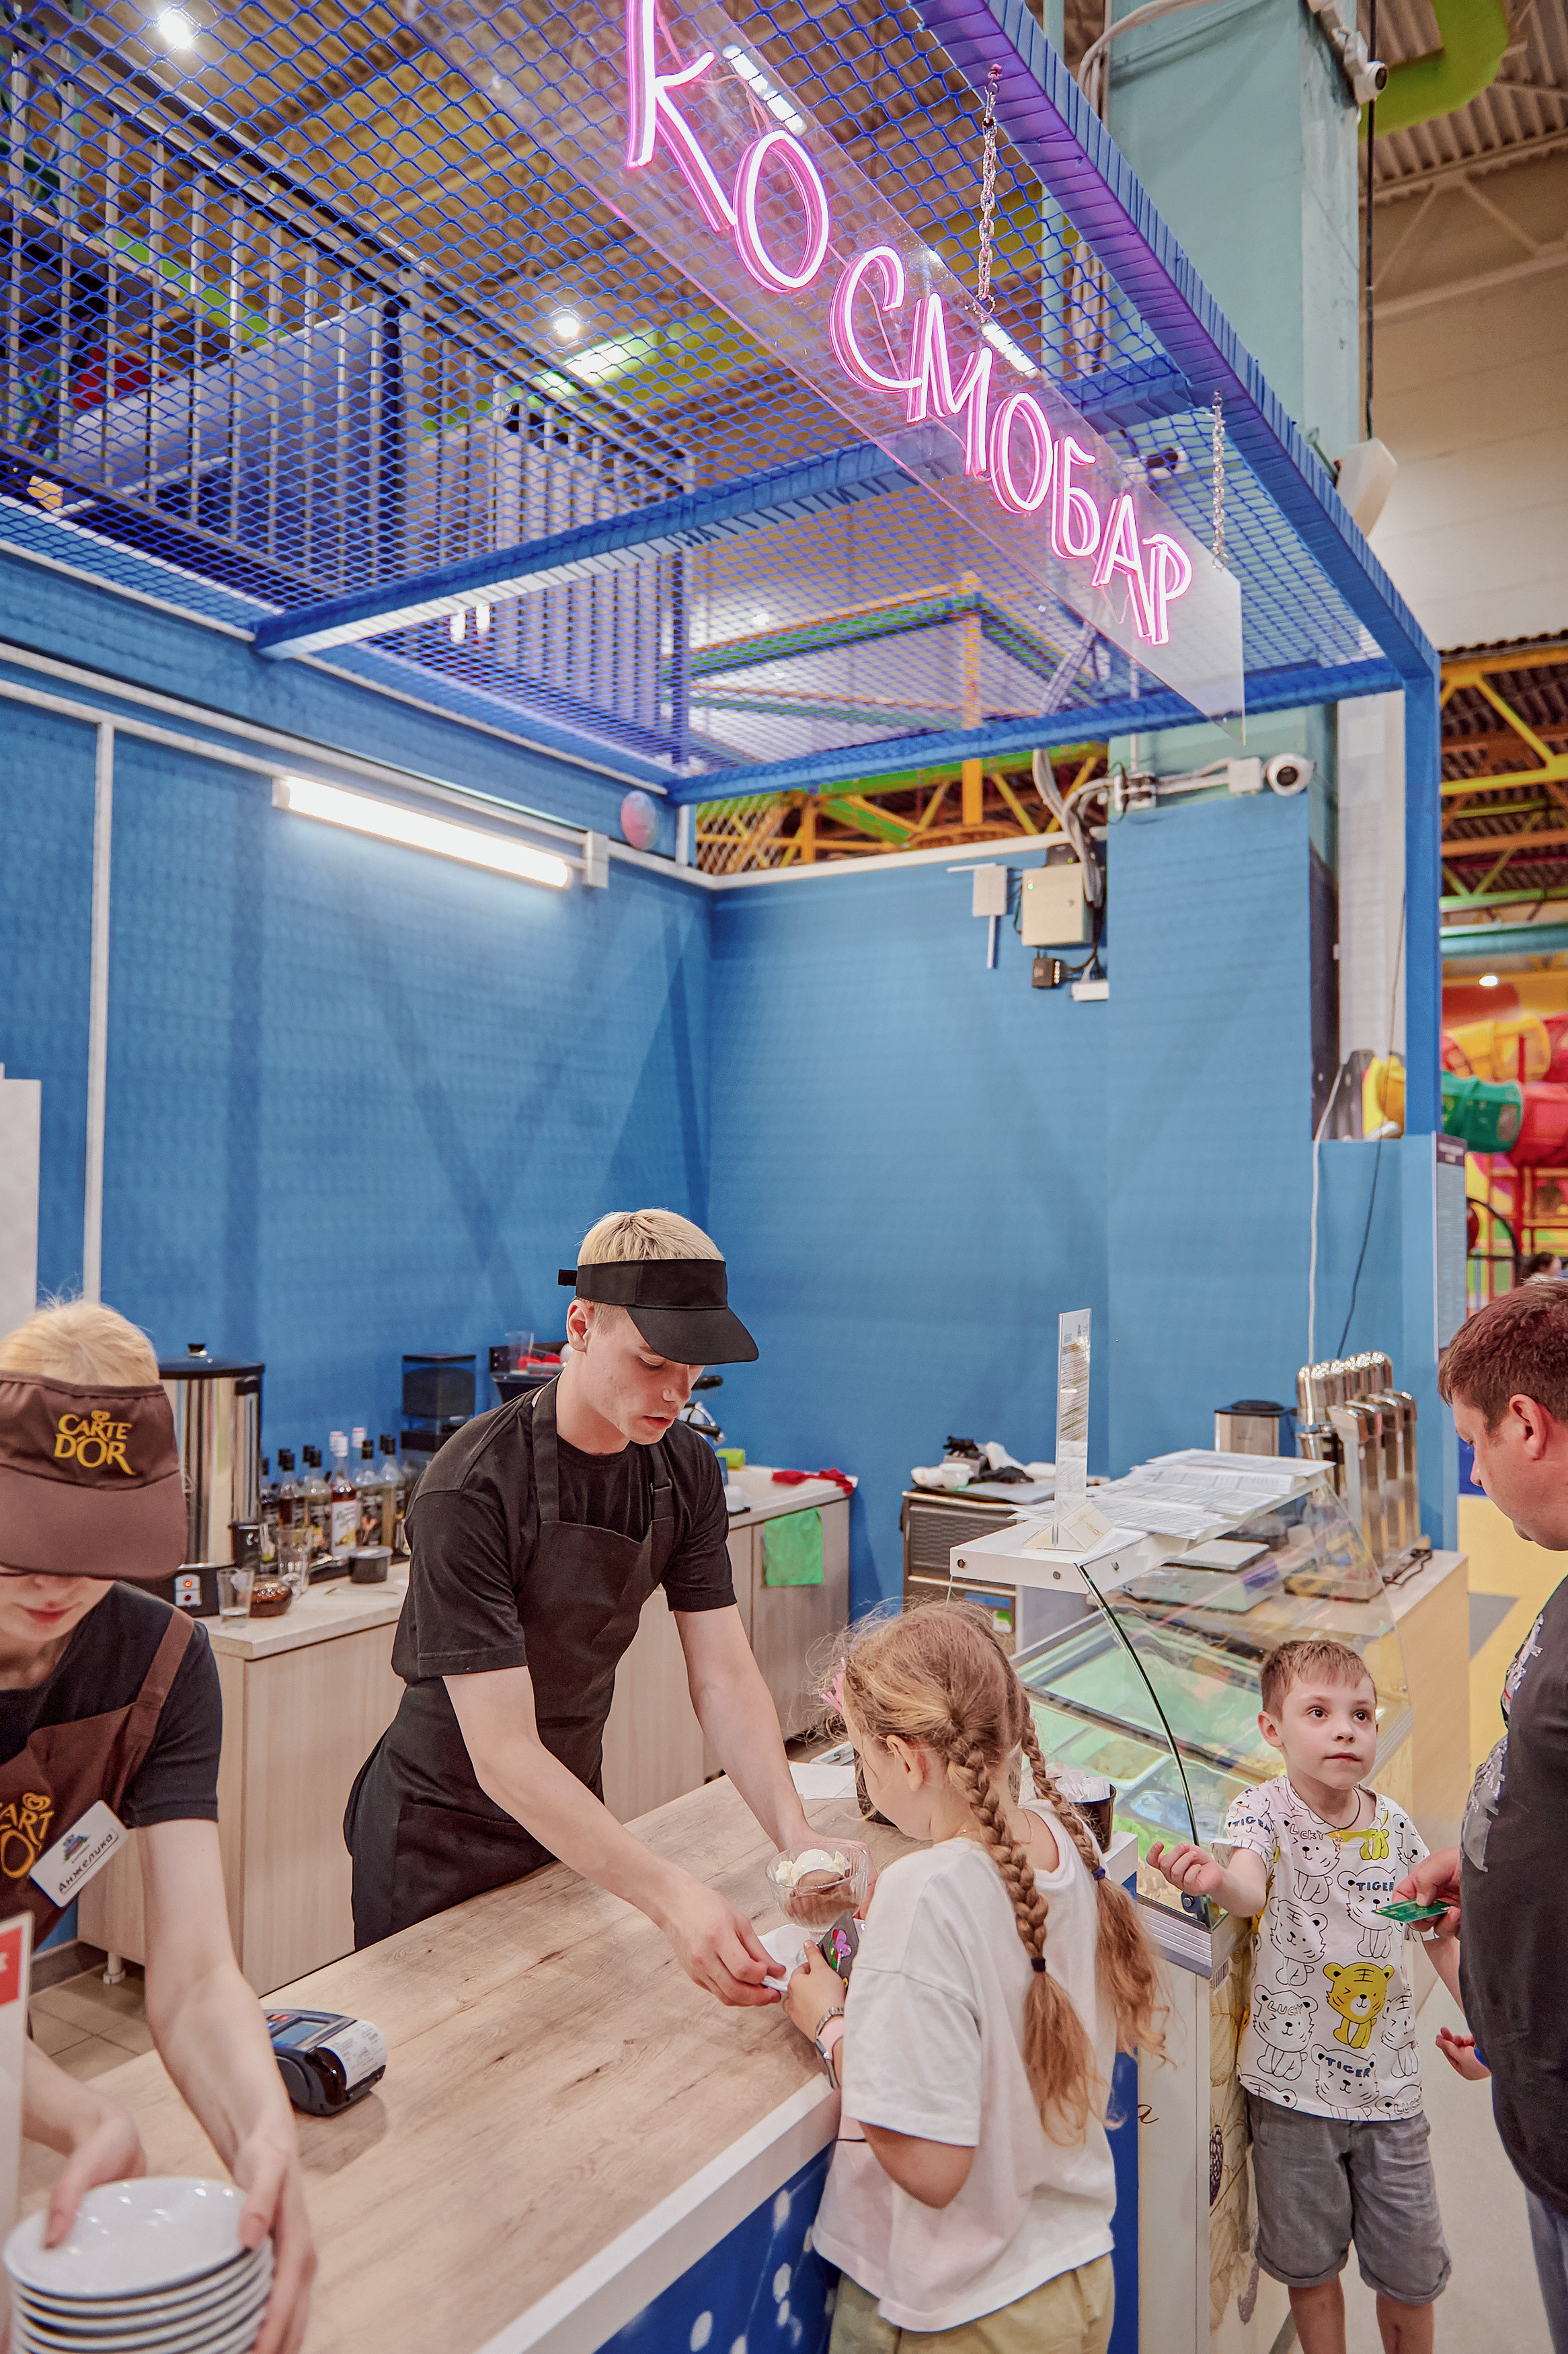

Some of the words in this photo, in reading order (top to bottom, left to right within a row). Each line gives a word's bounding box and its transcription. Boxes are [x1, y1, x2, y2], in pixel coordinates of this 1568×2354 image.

[626, 0, 1193, 646] КОСМОБАР
[58, 1414, 133, 1442] CARTE
[54, 1433, 136, 1476] D'OR
[1290, 1823, 1325, 1840] LCKY
[58, 1833, 114, 1893] Анжелика
[1325, 2057, 1371, 2078] TIGER
